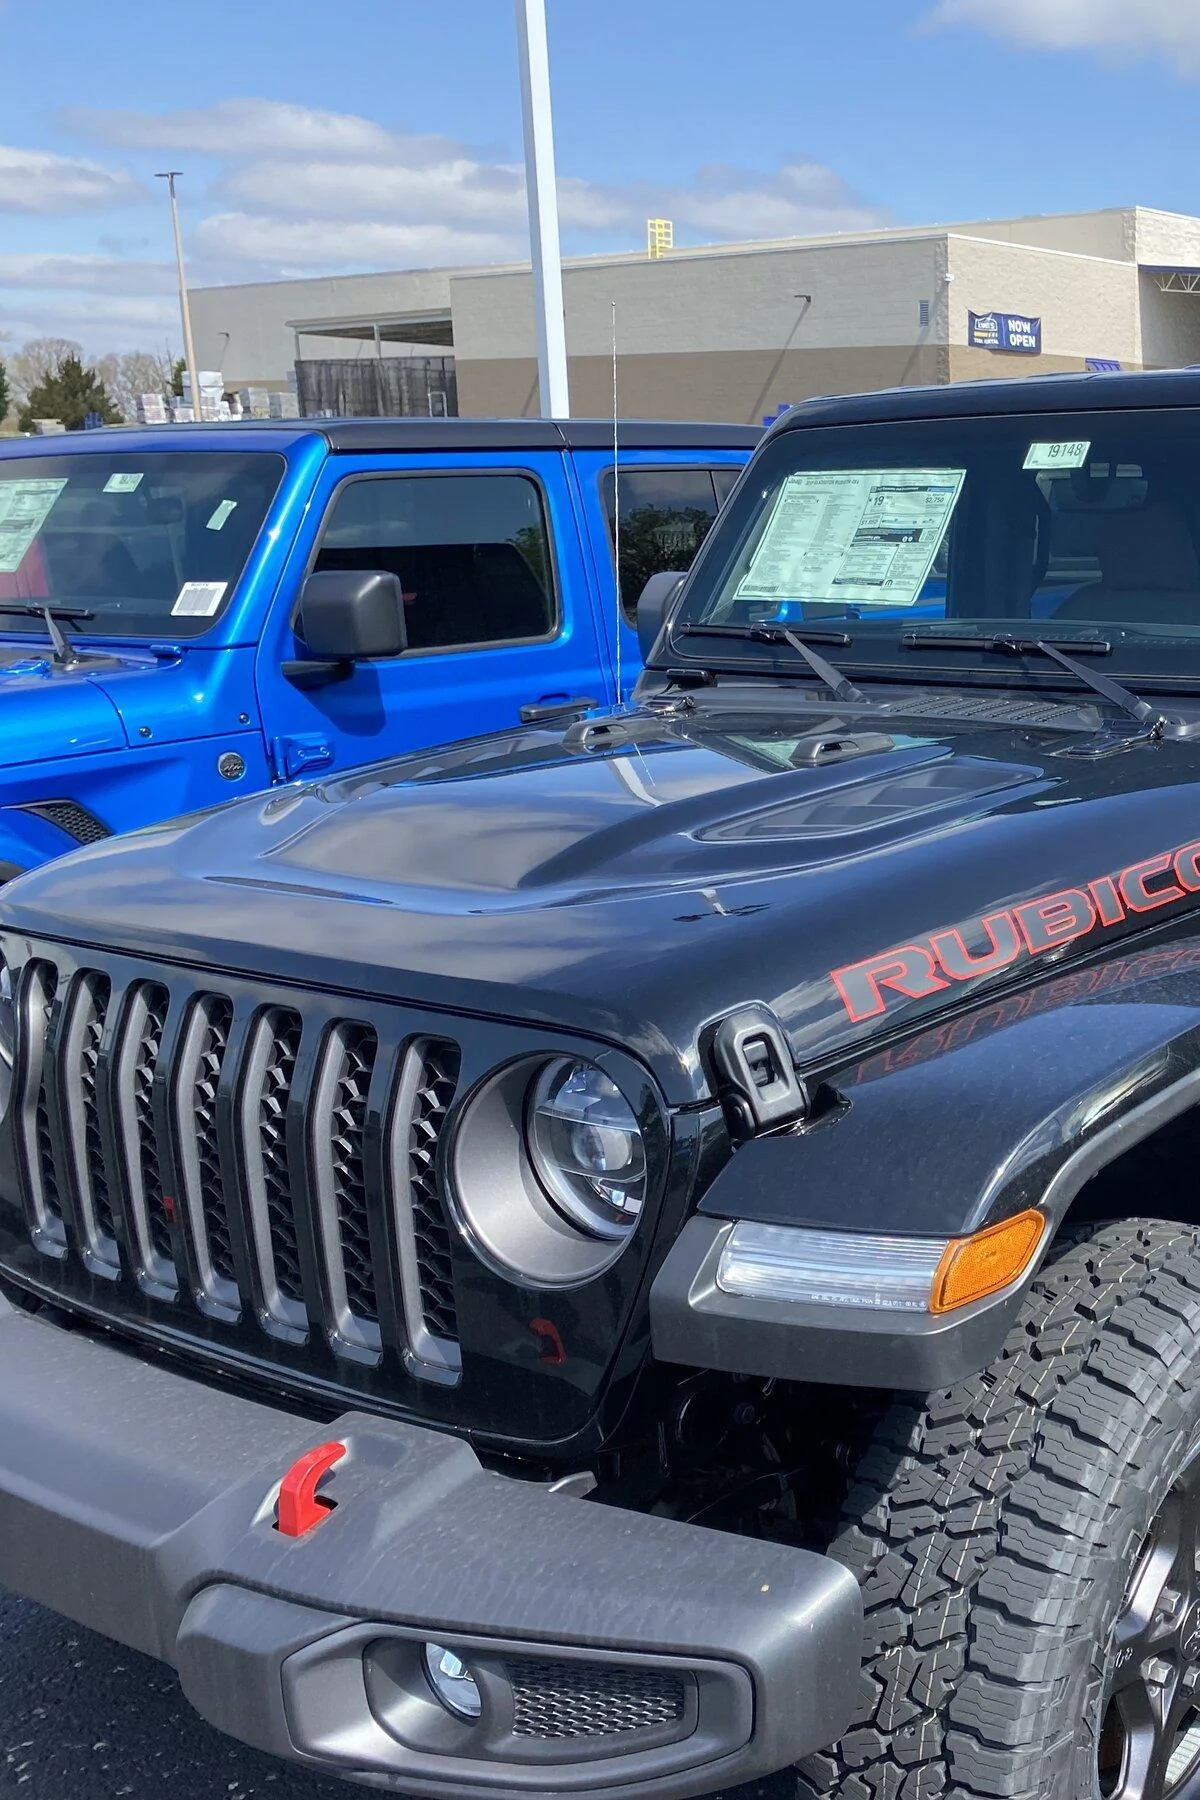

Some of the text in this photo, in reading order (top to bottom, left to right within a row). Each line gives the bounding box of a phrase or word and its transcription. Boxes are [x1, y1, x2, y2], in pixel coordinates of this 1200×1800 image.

[1008, 320, 1031, 333] NOW
[1009, 333, 1036, 348] OPEN
[1047, 443, 1083, 458] 19148
